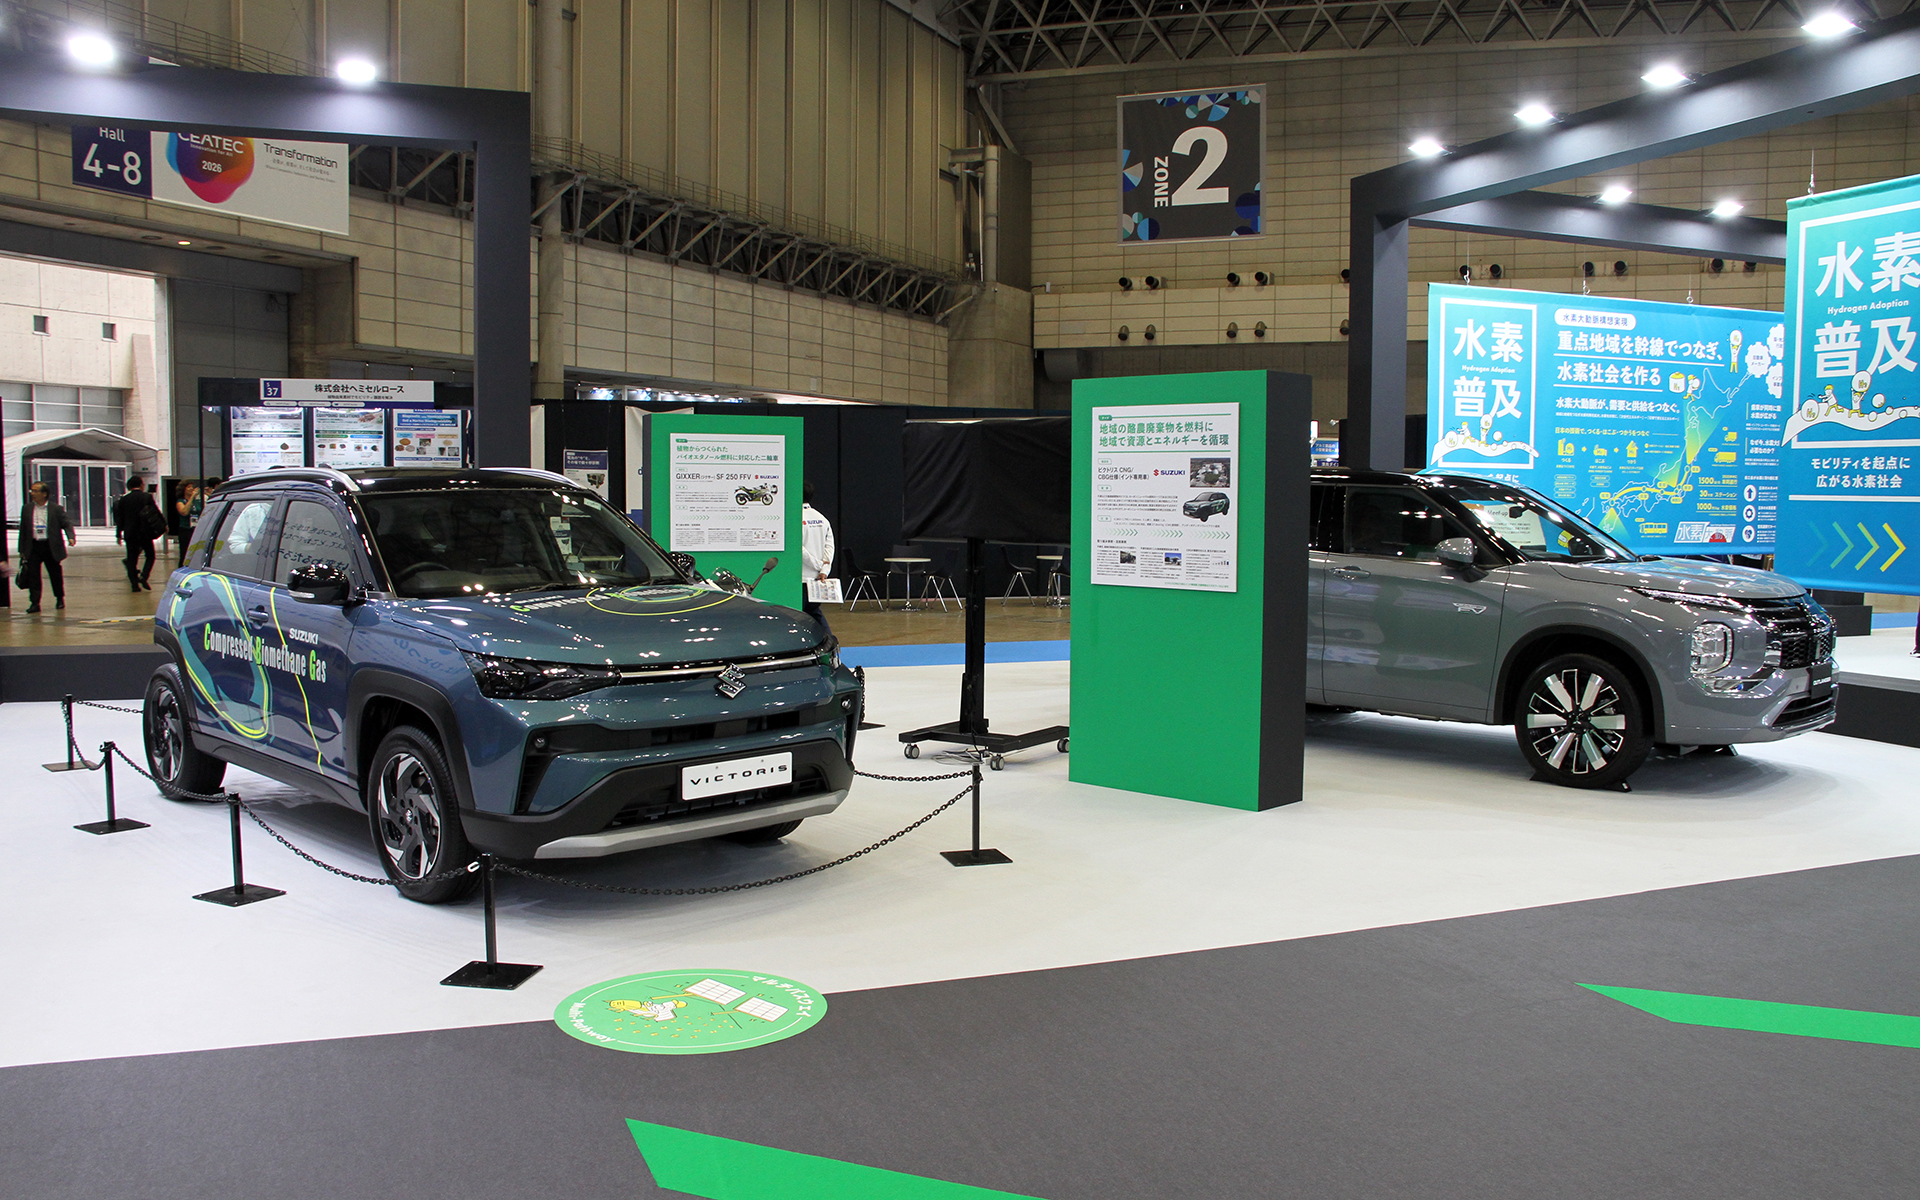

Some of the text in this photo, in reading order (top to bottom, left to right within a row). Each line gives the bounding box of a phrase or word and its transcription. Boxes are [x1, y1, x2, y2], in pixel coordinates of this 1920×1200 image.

[99, 127, 125, 142] Hall
[177, 133, 244, 154] CEATEC
[82, 143, 142, 185] 4-8
[263, 142, 338, 169] Transformation
[202, 160, 223, 173] 2026
[1172, 126, 1229, 206] 2
[1154, 156, 1169, 208] ZONE
[1815, 231, 1920, 298] 水素
[1827, 299, 1909, 315] Hydrogen Adoption
[1562, 313, 1629, 326] 水素大動脈構想実現
[1452, 319, 1524, 362] 水素
[1557, 330, 1723, 361] 重点地域を幹線でつなぎ、
[1813, 317, 1918, 378] 普及
[1461, 364, 1516, 374] Hydrogen Adoption
[1557, 361, 1662, 386] 水素社会を作る
[267, 388, 279, 396] 37
[314, 384, 405, 394] 株式会社ヘミセルロース
[1452, 375, 1523, 419] 普及
[1555, 397, 1681, 413] 水素大動脈が、需要と供給をつなぐ。
[1099, 421, 1214, 434] 地域の酪農廃棄物を燃料に
[1099, 434, 1229, 447] 地域で資源とエネルギーを循環
[1811, 456, 1911, 470] モビリティを起点に
[1816, 474, 1903, 488] 広がる水素社会
[289, 627, 319, 645] SUZUKI
[204, 622, 327, 683] Compressed Biomethane Gas
[690, 764, 788, 786] VICTORIS
